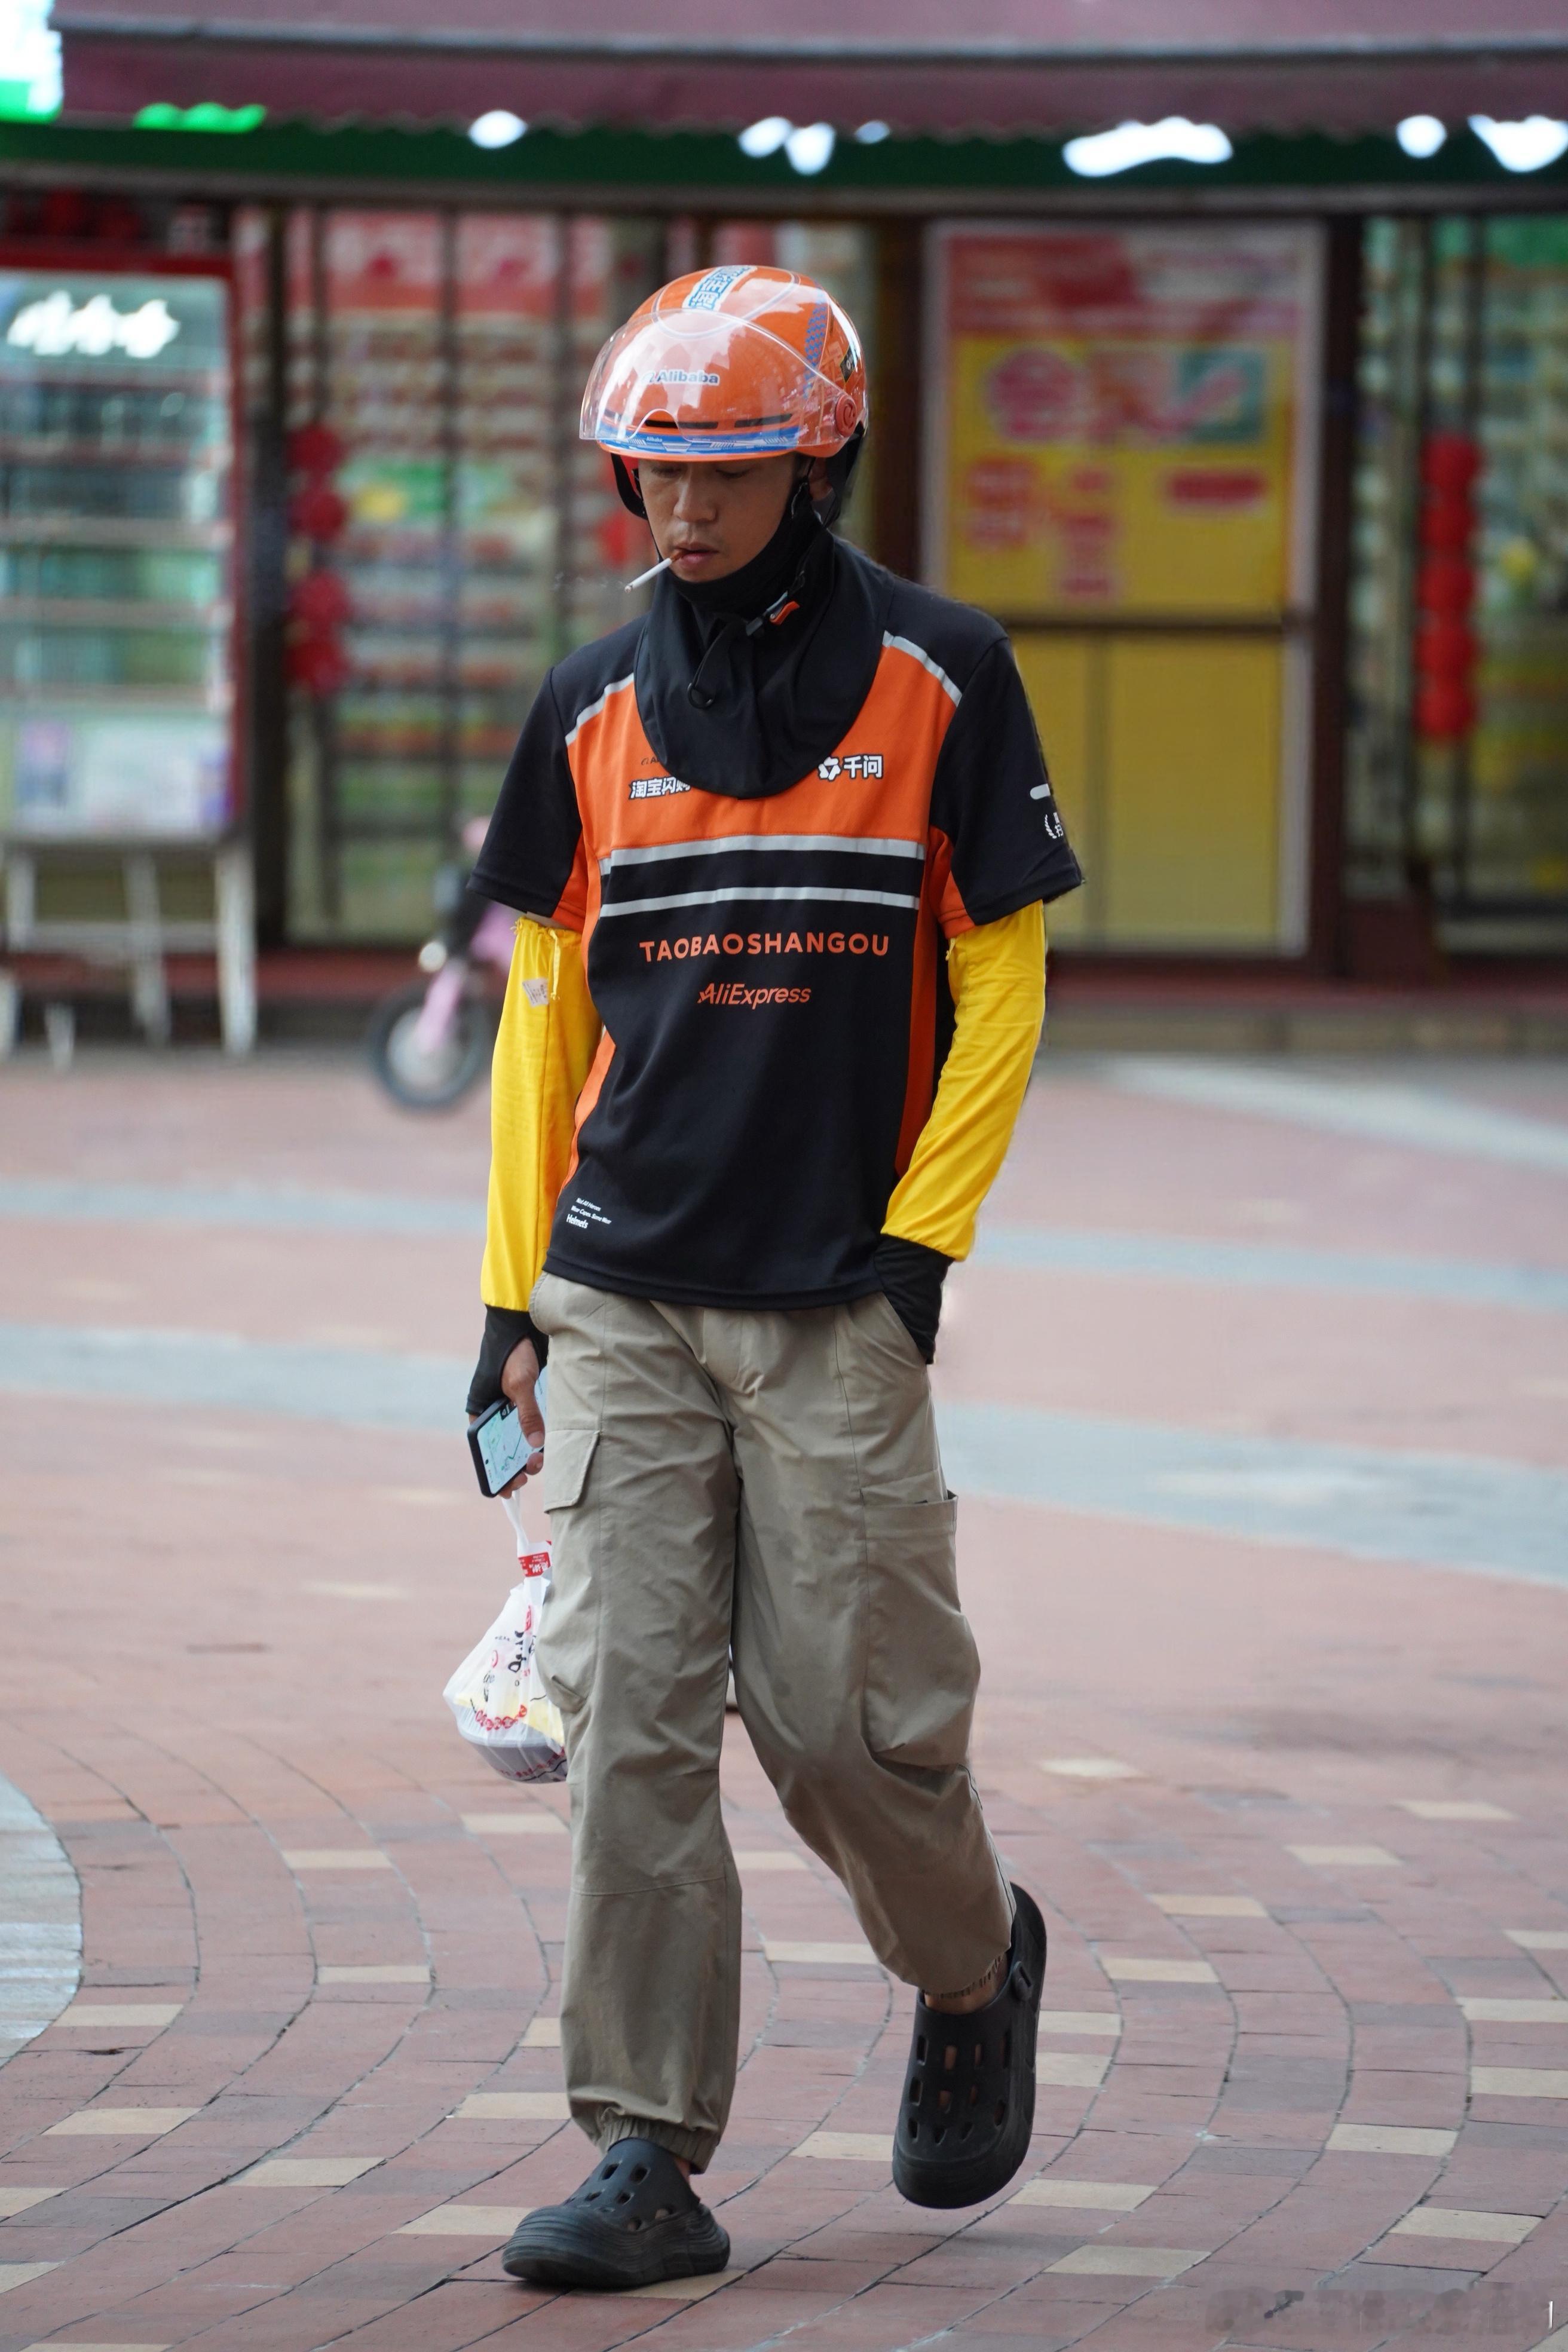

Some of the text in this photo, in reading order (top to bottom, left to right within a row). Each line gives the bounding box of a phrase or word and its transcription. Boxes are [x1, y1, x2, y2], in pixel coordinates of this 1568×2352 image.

[657, 370, 718, 383] Alibaba
[843, 755, 883, 779] 千问
[639, 932, 889, 963] TAOBAOSHANGOU
[697, 982, 811, 1010] AliExpress
[566, 1214, 589, 1229] Helmets
